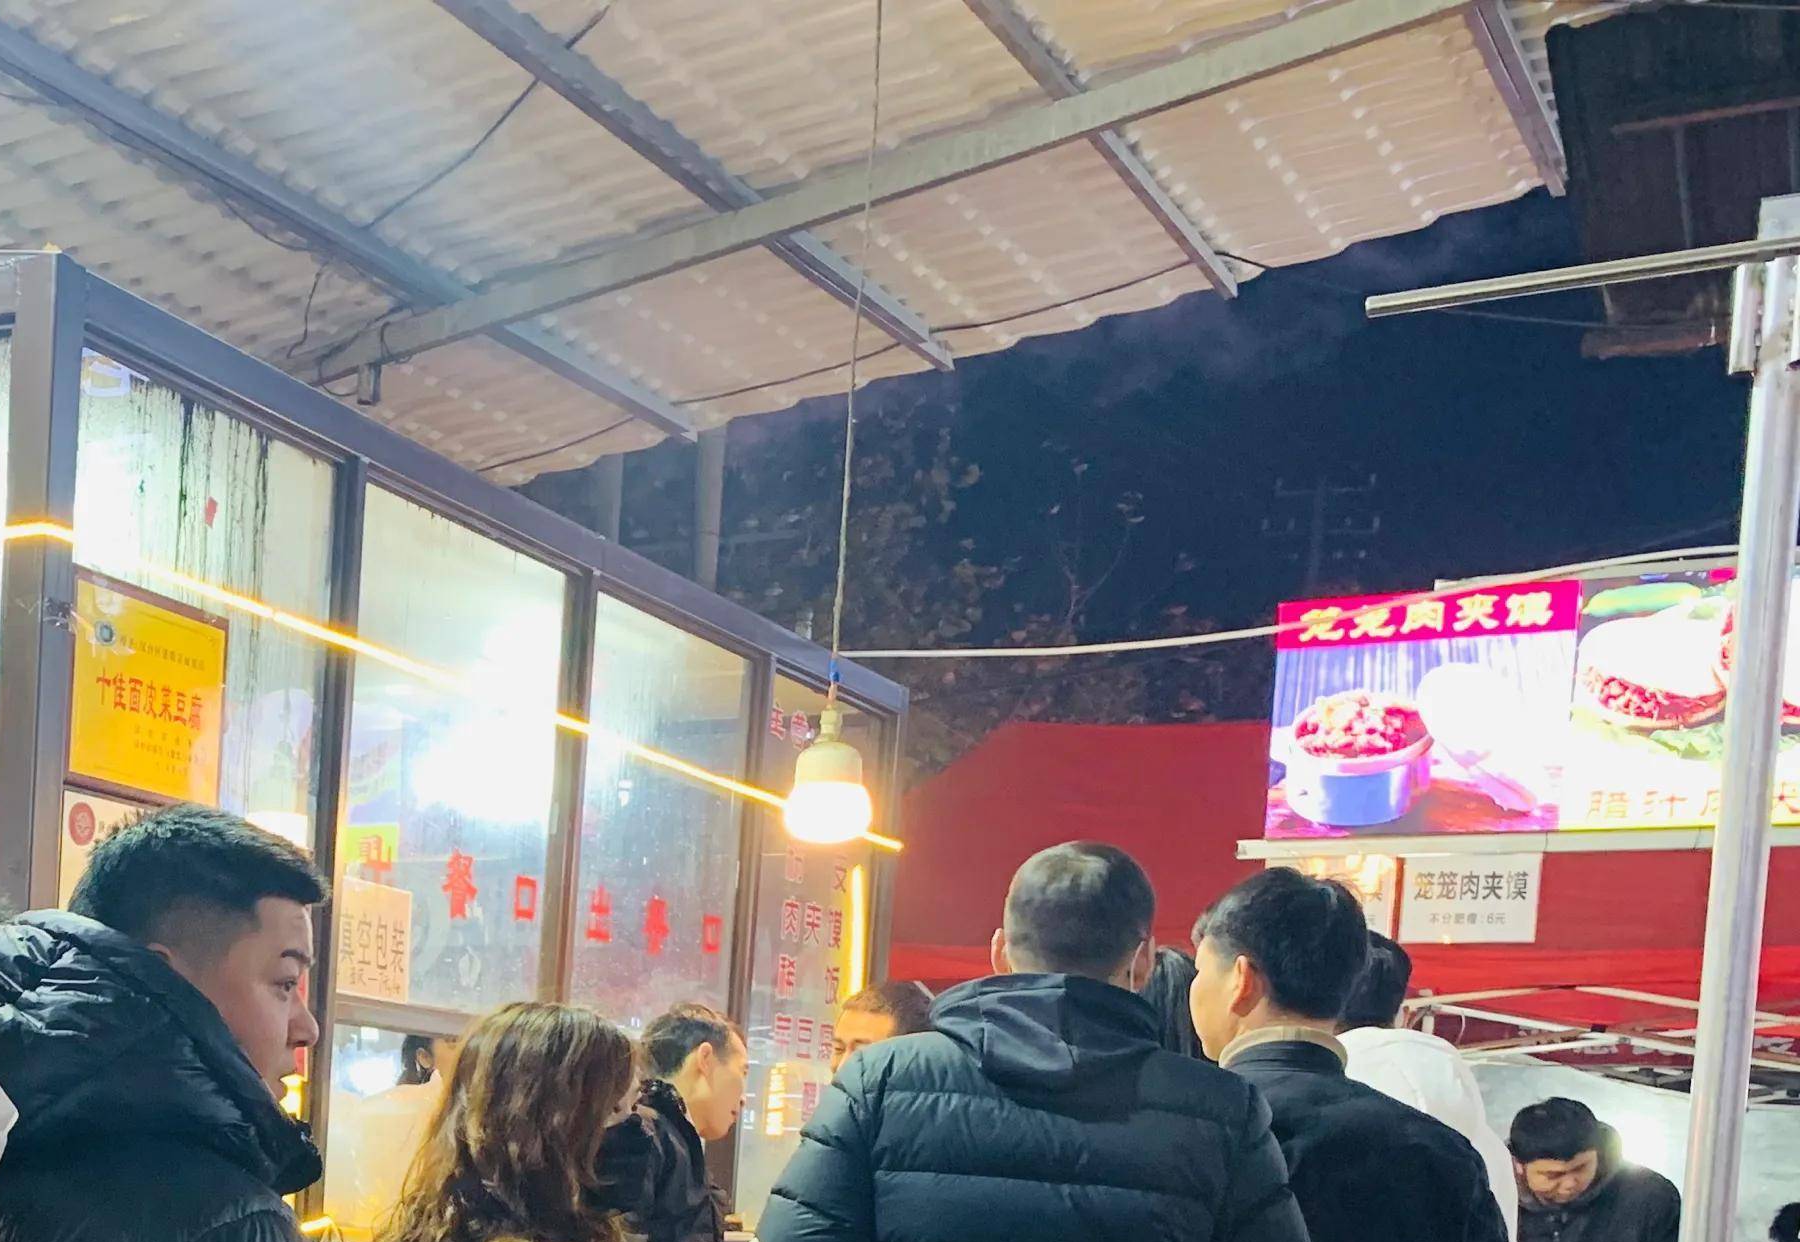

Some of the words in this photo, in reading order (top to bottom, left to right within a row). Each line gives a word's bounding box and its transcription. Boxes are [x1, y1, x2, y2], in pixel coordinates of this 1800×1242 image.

[1413, 870, 1529, 902] 笼笼肉夹馍
